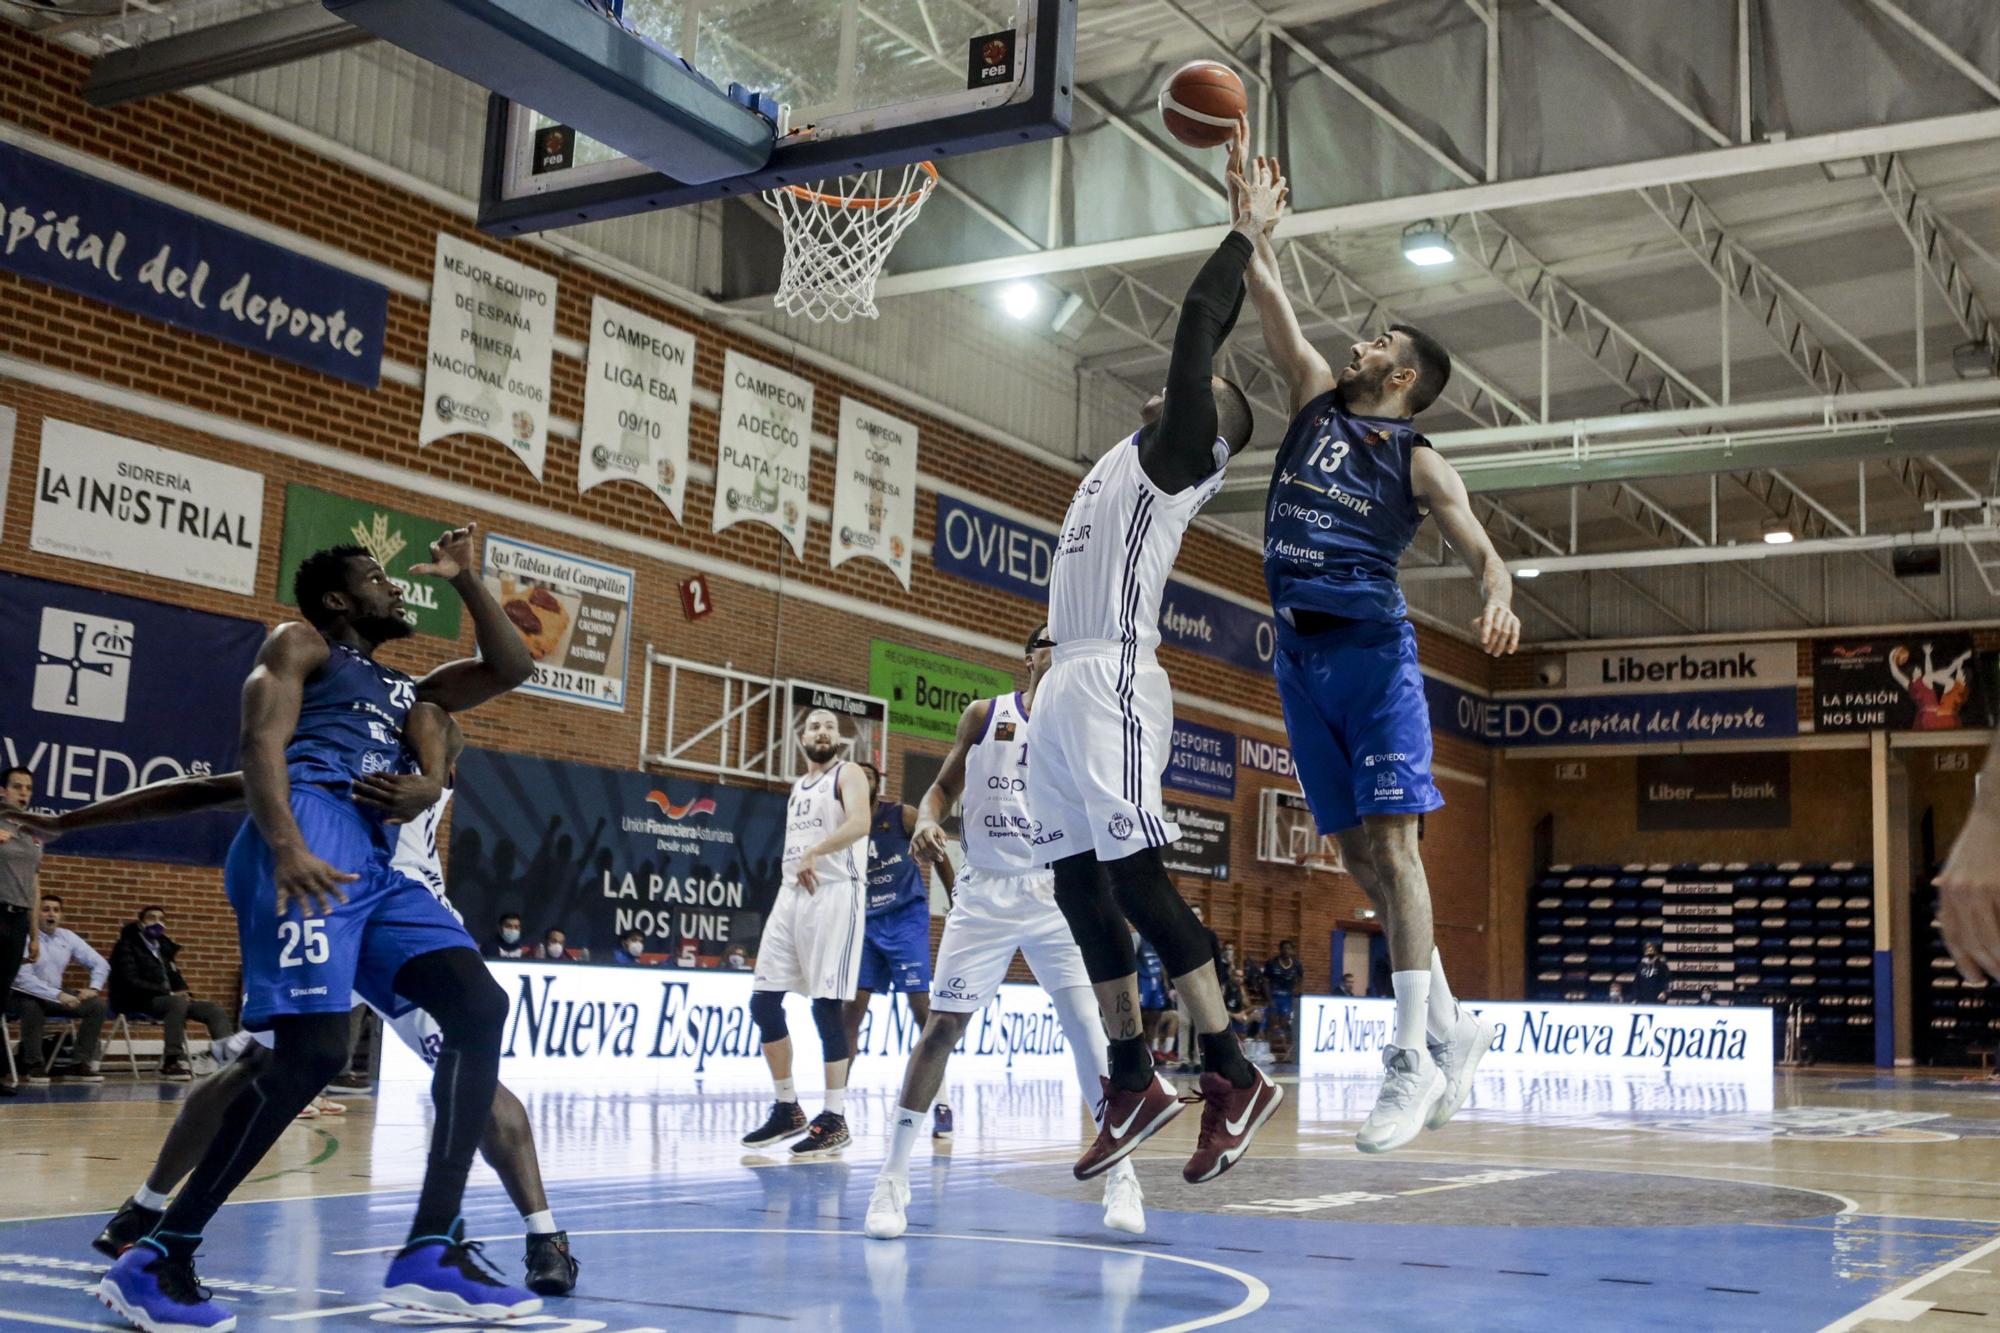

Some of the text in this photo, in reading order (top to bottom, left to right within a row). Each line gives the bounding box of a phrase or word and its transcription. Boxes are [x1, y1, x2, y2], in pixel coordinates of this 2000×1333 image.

[0, 202, 364, 358] pital del deporte
[443, 255, 548, 307] MEJOR EQUIPO
[455, 293, 532, 334] DE ESPAÑA
[460, 327, 522, 363] PRIMERA
[602, 318, 686, 366] CAMPEON
[432, 353, 543, 402] NACIONAL 05/06
[604, 365, 678, 406] LIGA EBA
[735, 369, 806, 413] CAMPEON
[617, 408, 661, 440] 09/10
[737, 411, 799, 449] ADECCO
[855, 417, 903, 446] CAMPEON
[723, 445, 806, 492] PLATA 12/13
[864, 448, 891, 467] COPA
[1307, 434, 1350, 474] 13
[40, 466, 72, 504] LA
[117, 461, 192, 494] SIDRERÍA
[853, 470, 901, 498] PRINCESA
[1278, 502, 1333, 530] OVIEDO
[1326, 484, 1373, 518] bank
[490, 546, 510, 568] Las
[512, 551, 551, 577] Tablas
[552, 562, 570, 581] del
[945, 508, 1050, 588] OVIED
[1275, 539, 1325, 561] Asturias
[581, 606, 590, 618] EL
[689, 580, 706, 614] 2
[1163, 603, 1213, 642] deporte
[531, 667, 595, 694] 85 212 411
[1601, 651, 1757, 684] Liberbank
[1822, 689, 1898, 707] LA PASIÓN
[1458, 695, 1766, 741] OVIEDO capital del deporte
[1823, 711, 1885, 726] NOS UNE
[1172, 730, 1222, 757] DEPORTE
[1374, 752, 1405, 763] OVIEDO
[0, 736, 213, 803] VIEDO.es
[1171, 751, 1233, 779] ASTURIANO
[987, 775, 1027, 796] asp
[1374, 788, 1404, 797] Asturias
[603, 869, 743, 909] LA PASIÓN
[615, 907, 730, 942] NOS UNE
[278, 918, 330, 969] 25
[935, 990, 979, 1001] LEXUS
[501, 974, 762, 1073] Nueva Espa
[1314, 1004, 1337, 1053] La
[1341, 1005, 1386, 1053] Nueva
[1515, 1010, 1613, 1057] Nueva
[1622, 1013, 1749, 1068] España
